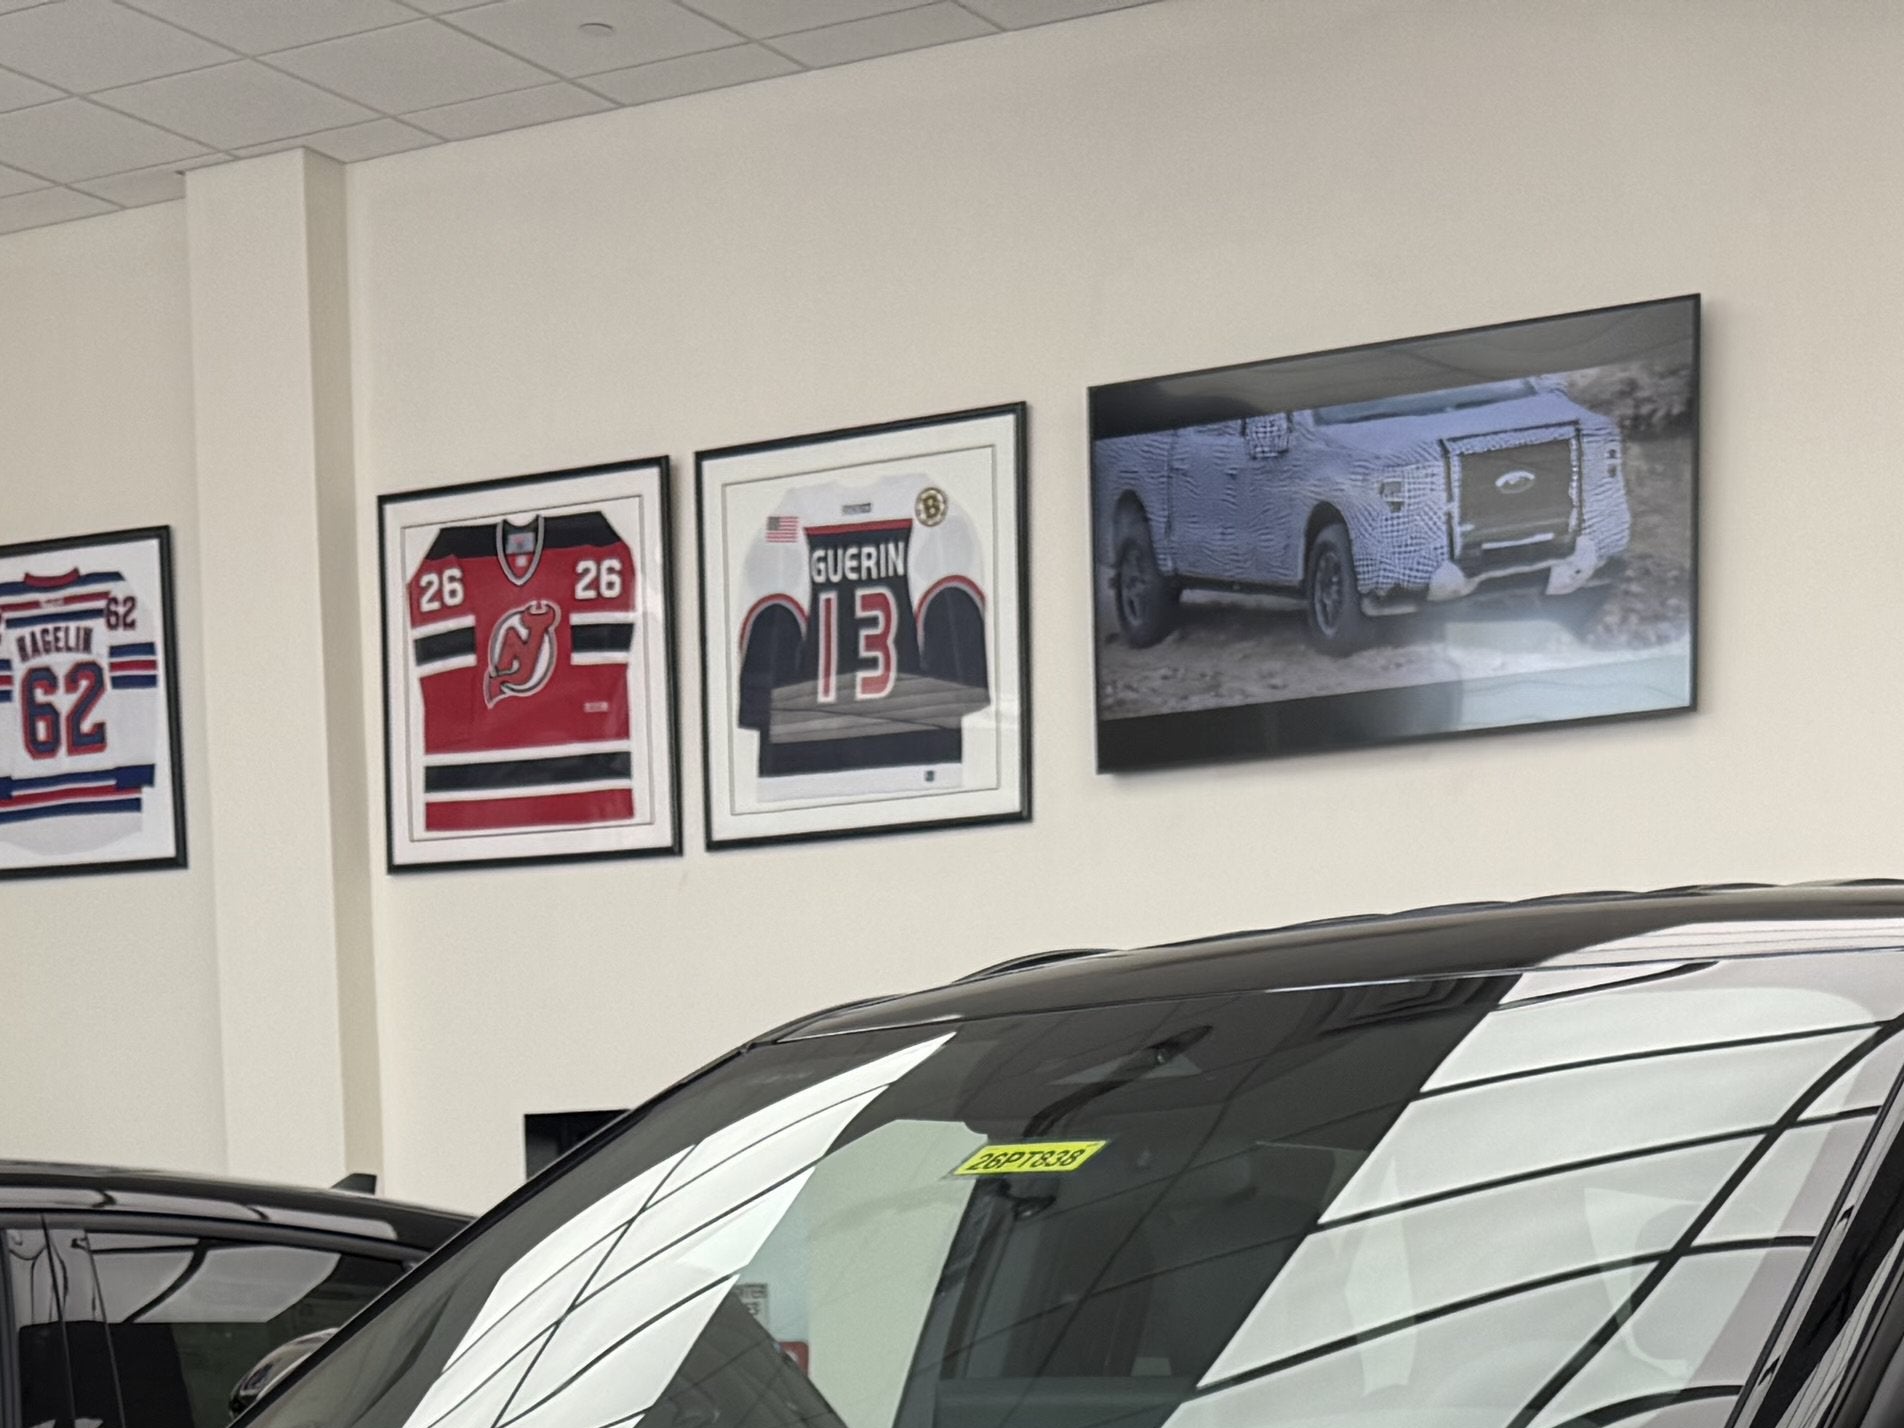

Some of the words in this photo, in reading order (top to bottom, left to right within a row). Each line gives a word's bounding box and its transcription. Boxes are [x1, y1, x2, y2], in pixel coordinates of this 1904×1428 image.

[574, 558, 623, 601] 26
[811, 541, 907, 584] GUERIN
[418, 568, 465, 613] 26
[105, 595, 137, 631] 62
[817, 586, 897, 703] 13
[20, 660, 108, 761] 62
[966, 1148, 1088, 1171] 26PT838
